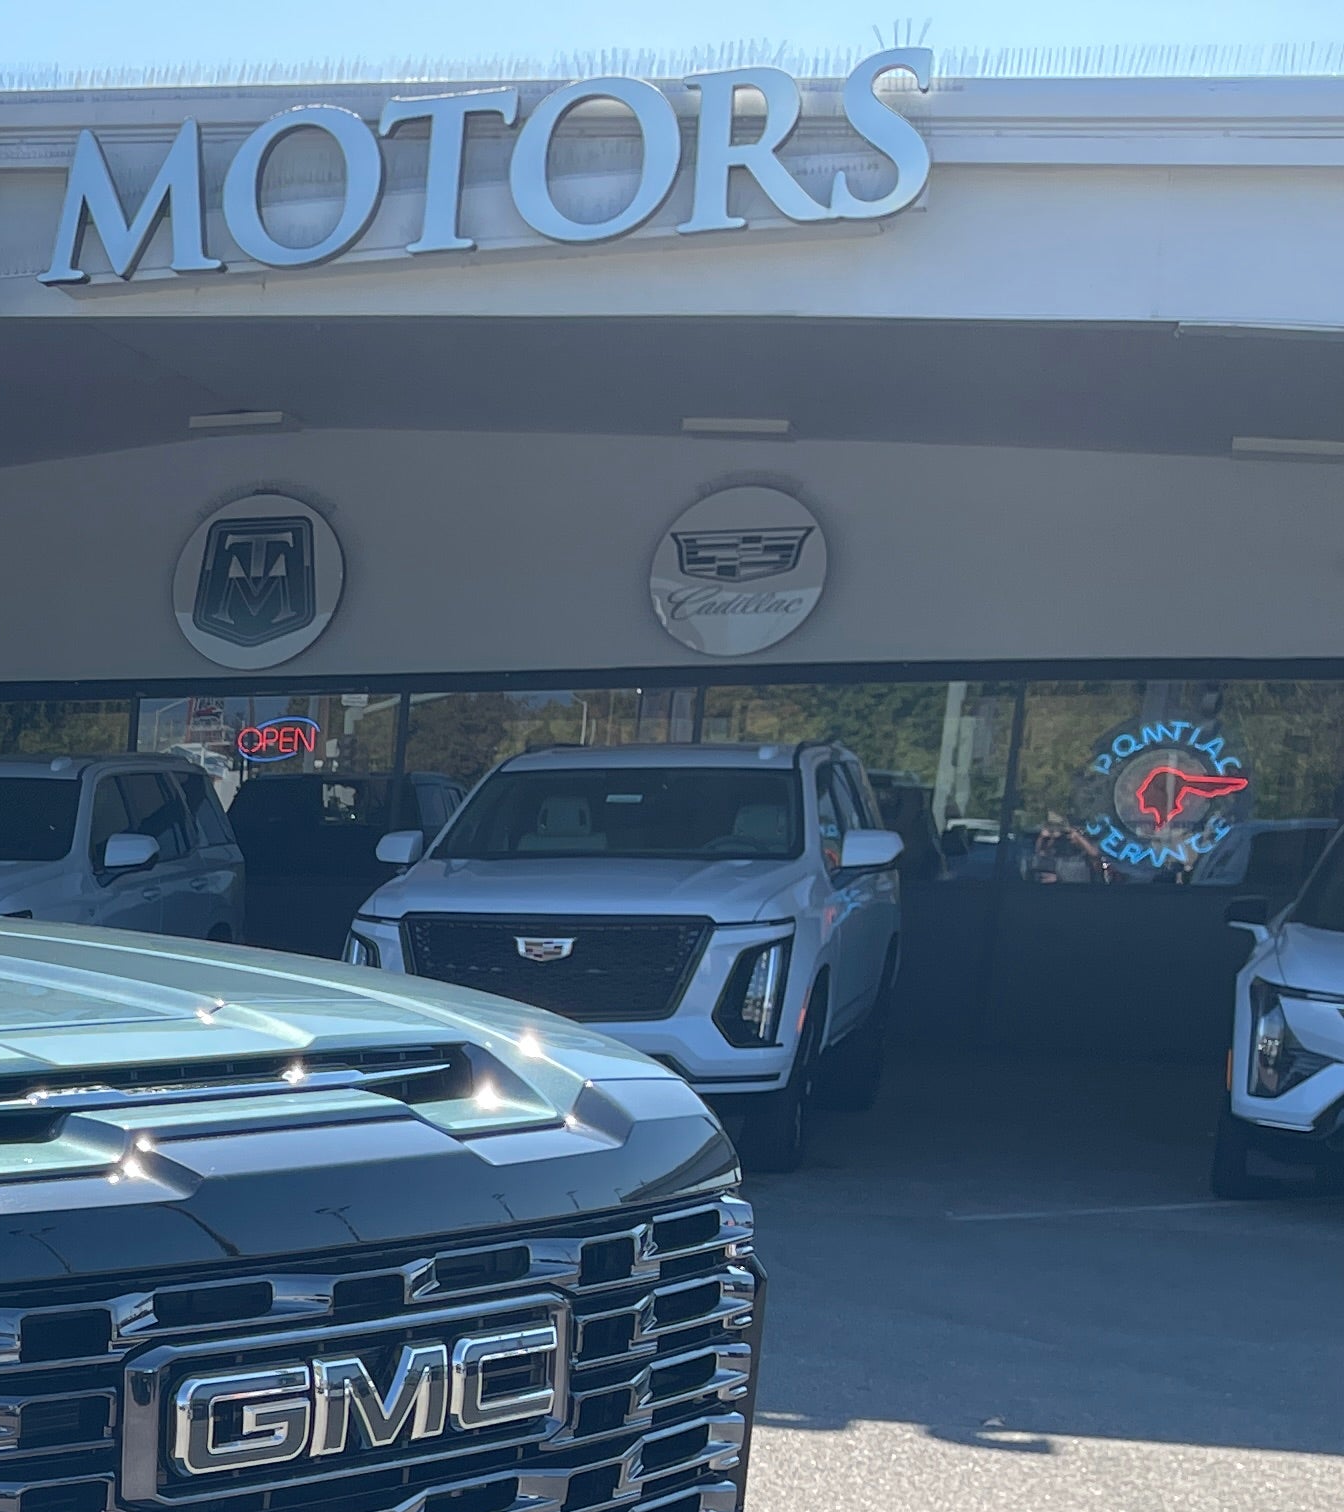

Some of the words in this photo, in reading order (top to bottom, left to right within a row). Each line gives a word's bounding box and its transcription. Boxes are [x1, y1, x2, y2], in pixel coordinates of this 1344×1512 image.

[36, 47, 933, 286] MOTORS
[667, 584, 803, 620] Cadillac
[237, 727, 316, 753] OPEN
[1092, 720, 1242, 775] PONTIAC
[175, 1322, 559, 1475] GMC
